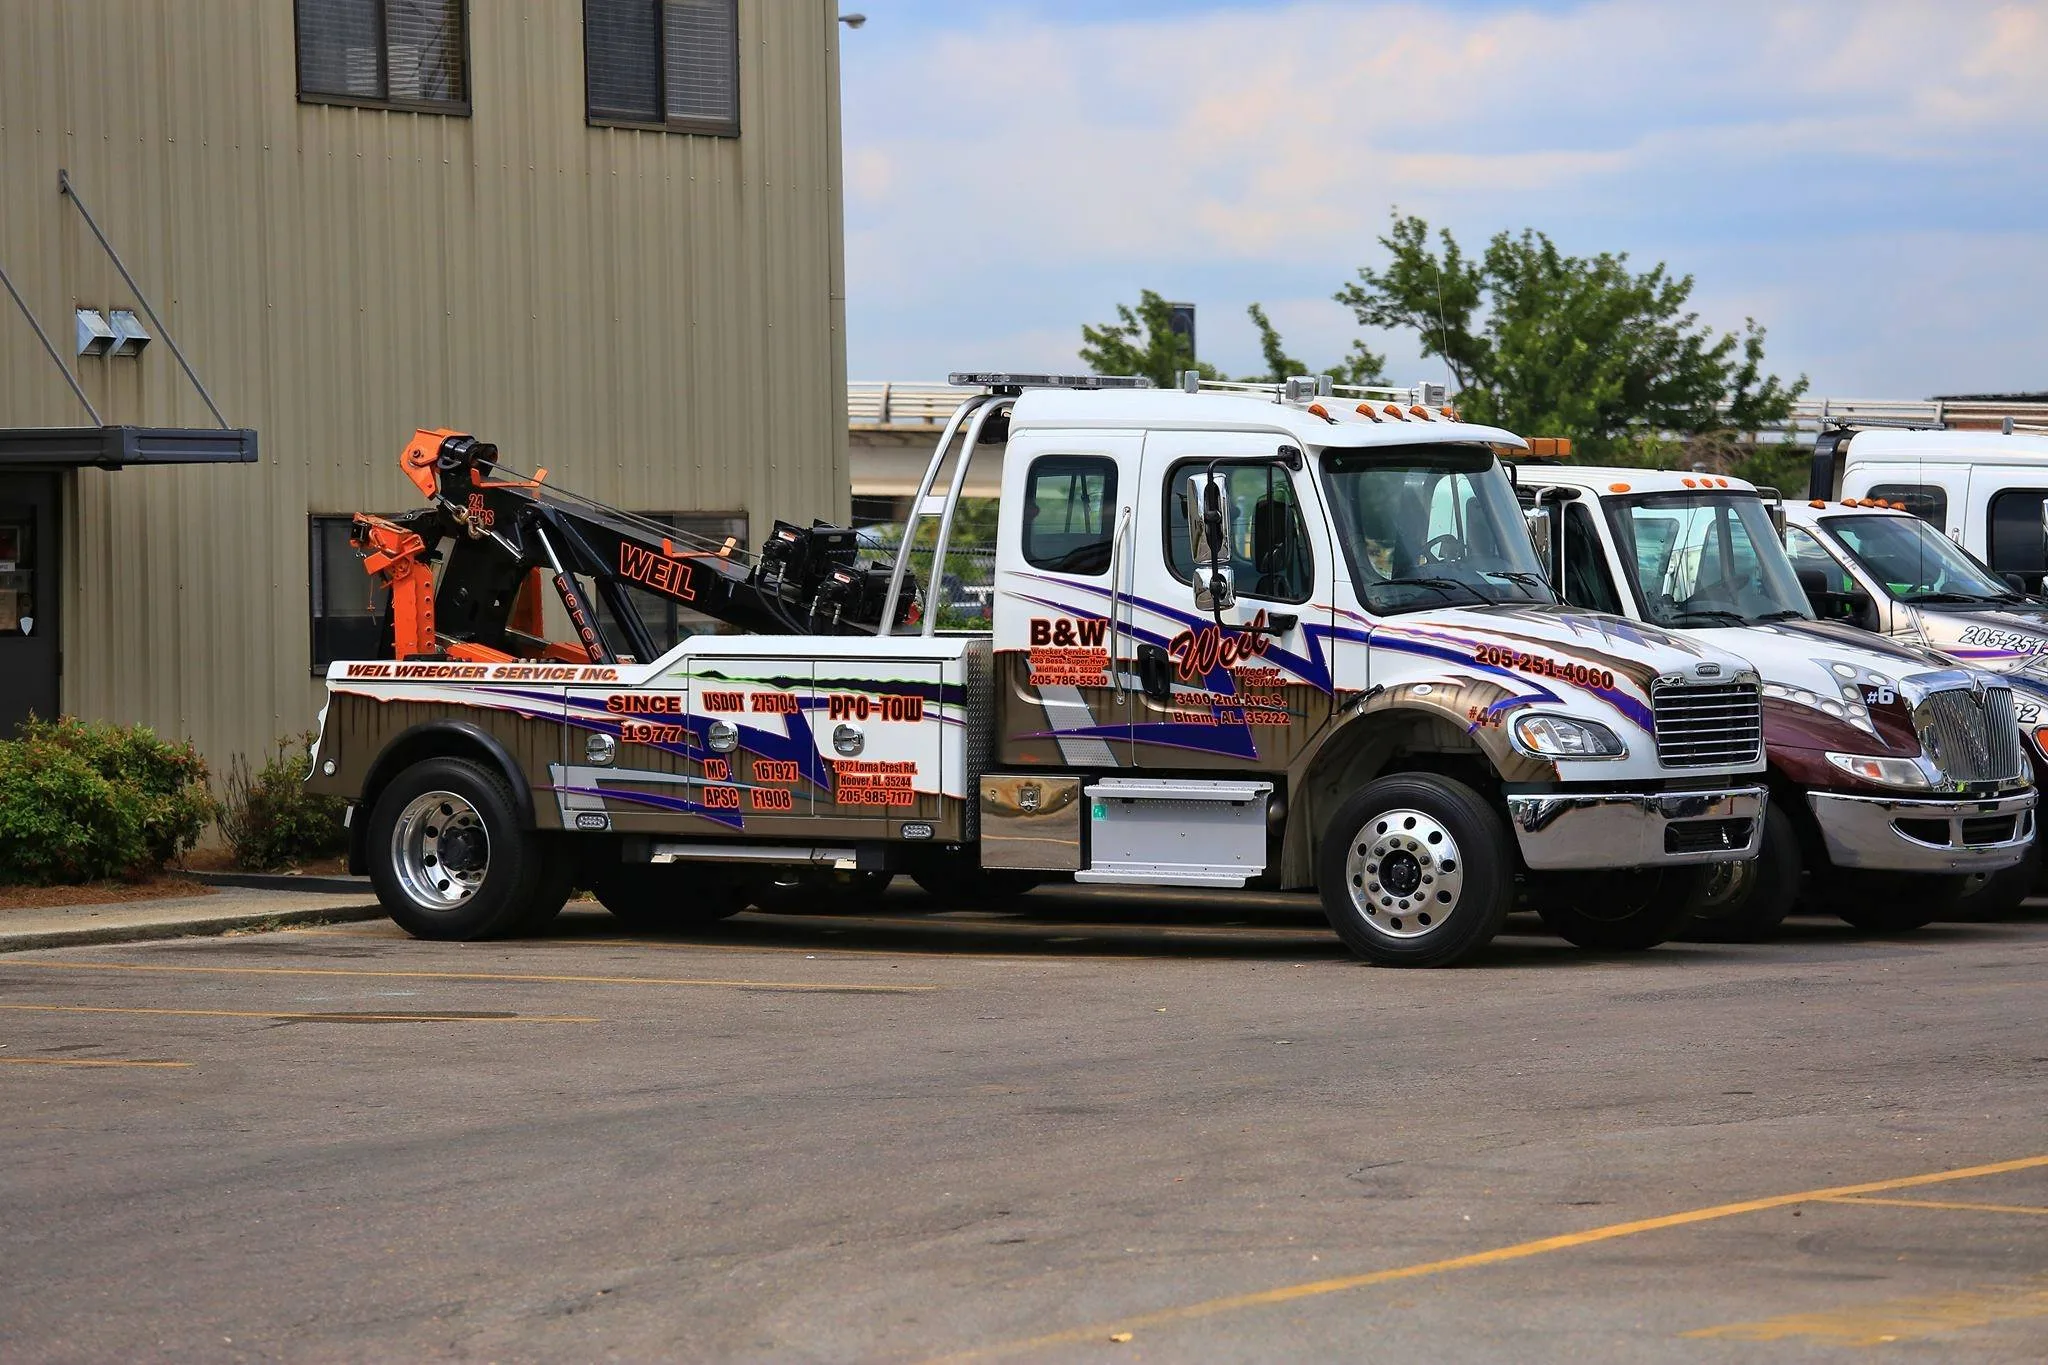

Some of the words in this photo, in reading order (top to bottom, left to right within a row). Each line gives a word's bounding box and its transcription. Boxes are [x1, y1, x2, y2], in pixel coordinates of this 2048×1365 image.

[469, 494, 483, 510] 24
[621, 542, 695, 600] WEIL
[1030, 618, 1107, 647] B&W
[1031, 647, 1062, 656] Wrecker
[1063, 647, 1090, 656] Service
[1091, 648, 1107, 656] LLC
[1169, 608, 1270, 680] Weil
[347, 664, 391, 677] WEIL
[394, 665, 486, 678] WRECKER
[492, 666, 575, 680] SERVICE
[578, 668, 619, 681] INC.
[1036, 666, 1067, 675] Midfield,
[1235, 666, 1280, 676] Wrecker
[1475, 644, 1614, 691] 205-251-4060
[1031, 675, 1108, 686] 205-786-5530
[1245, 676, 1287, 686] Service
[702, 692, 745, 712] USDOT
[751, 693, 798, 713] 275704
[1176, 693, 1211, 705] 3400
[1214, 693, 1240, 706] 2nd
[1243, 694, 1270, 706] Ave
[1271, 694, 1287, 706] S.
[1866, 685, 1895, 704] #6
[607, 695, 681, 713] SINCE
[1174, 711, 1218, 725] Bham,
[1221, 711, 1243, 724] AL.
[1245, 712, 1290, 725] 35222
[1469, 705, 1503, 728] #44
[622, 724, 682, 742] 1977
[705, 759, 728, 780] MC
[753, 761, 799, 781] 167927
[835, 761, 854, 772] 1872
[855, 761, 878, 773] Lorna
[879, 761, 902, 773] Crest
[840, 775, 870, 787] Hoover,
[885, 776, 911, 788] 35244
[705, 787, 739, 807] APSC
[752, 789, 792, 809] F1908
[839, 790, 914, 804] 205-985-7177
